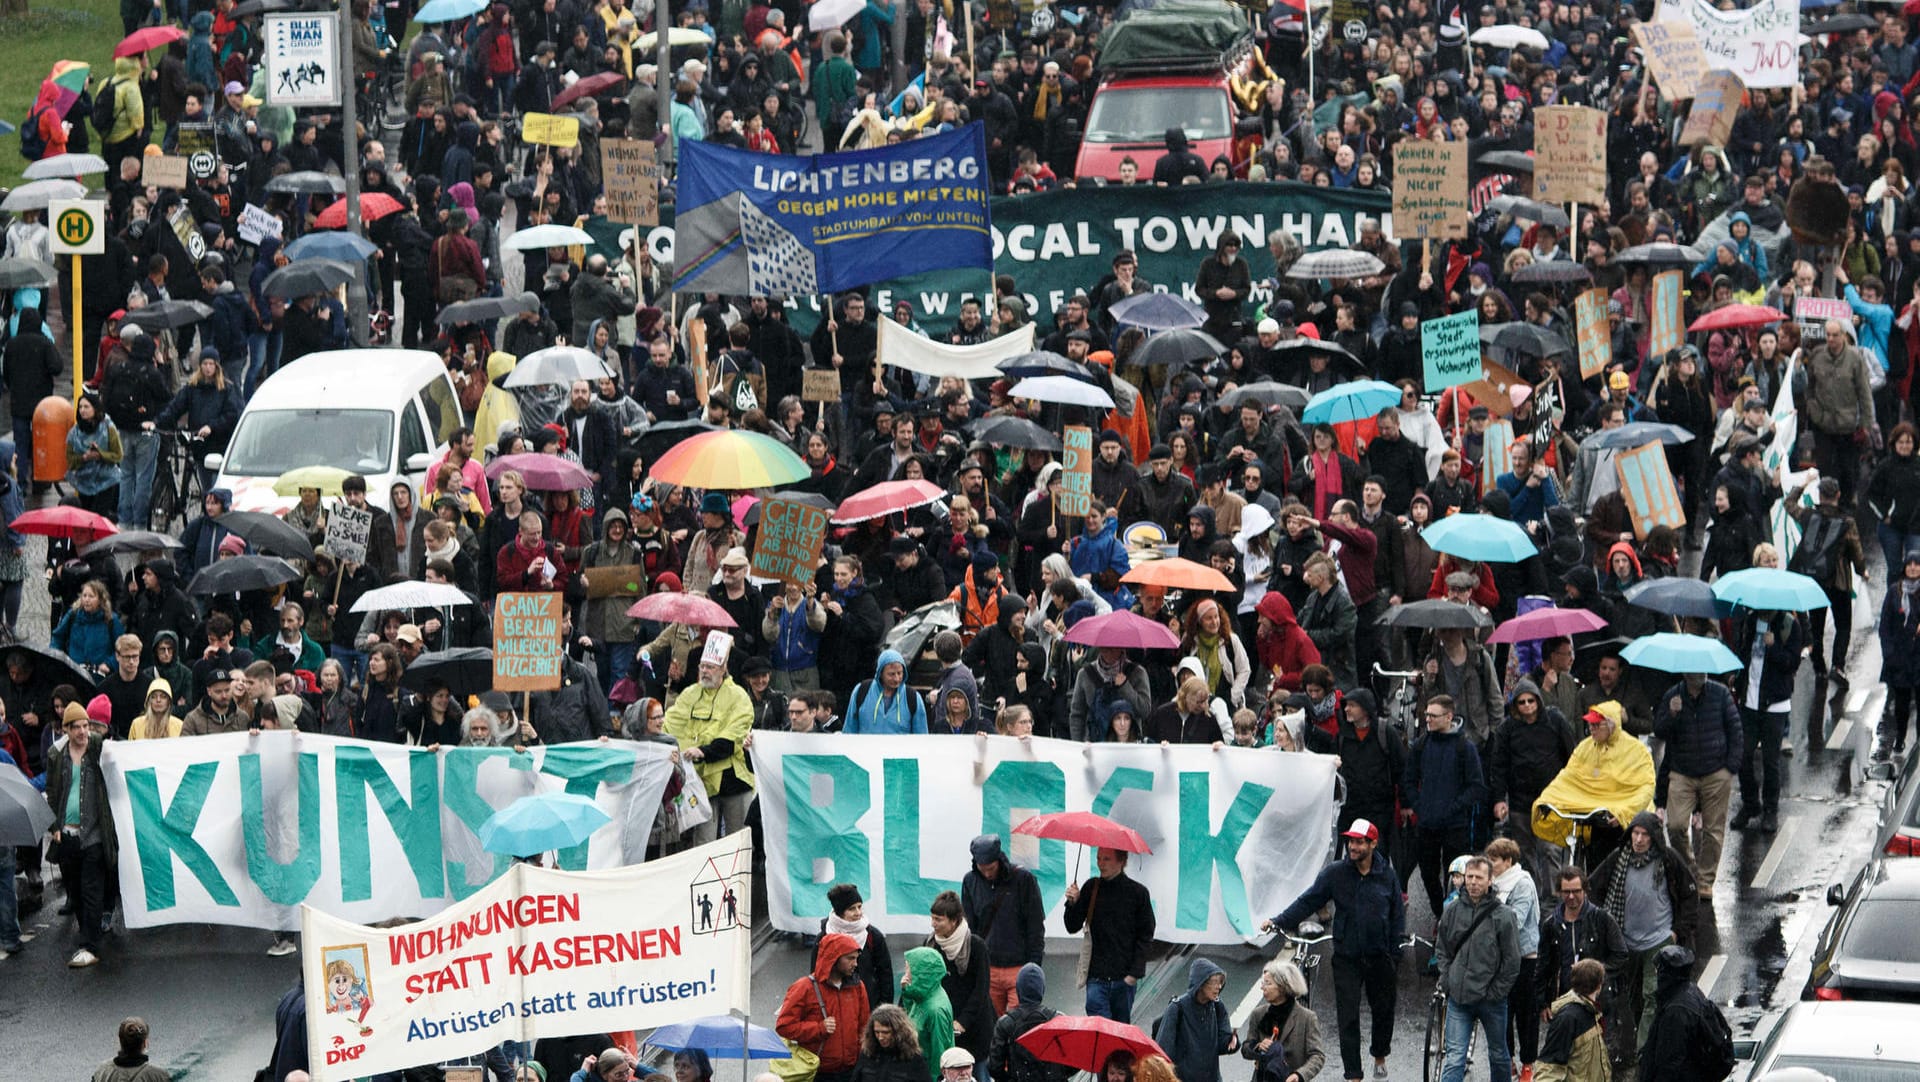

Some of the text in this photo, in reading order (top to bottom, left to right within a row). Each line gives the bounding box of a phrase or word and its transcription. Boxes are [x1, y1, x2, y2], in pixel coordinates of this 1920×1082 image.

[290, 21, 321, 29] BLUE
[290, 30, 322, 40] MAN
[754, 156, 979, 195] LICHTENBERG
[778, 187, 987, 217] GEGEN HOHE MIETEN!
[66, 216, 84, 238] H
[936, 211, 985, 225] UNTEN!
[1114, 213, 1266, 253] TOWN
[1436, 330, 1465, 346] Stadt
[1436, 357, 1480, 374] Wohnungen
[333, 503, 351, 521] WE
[766, 500, 826, 533] GELD
[763, 520, 819, 549] WERTET
[762, 538, 811, 562] AB UND
[754, 552, 794, 576] NICHT
[500, 594, 553, 617] GANZ
[504, 617, 556, 636] BERLIN
[496, 656, 561, 678] UTZGEBIET
[124, 744, 638, 912] KUNST
[388, 892, 581, 966] WOHNUNGEN
[405, 925, 682, 1004] STATT KASERNEN
[407, 968, 718, 1042] Abrüsten statt aufrüsten!
[326, 1043, 366, 1066] DKP
